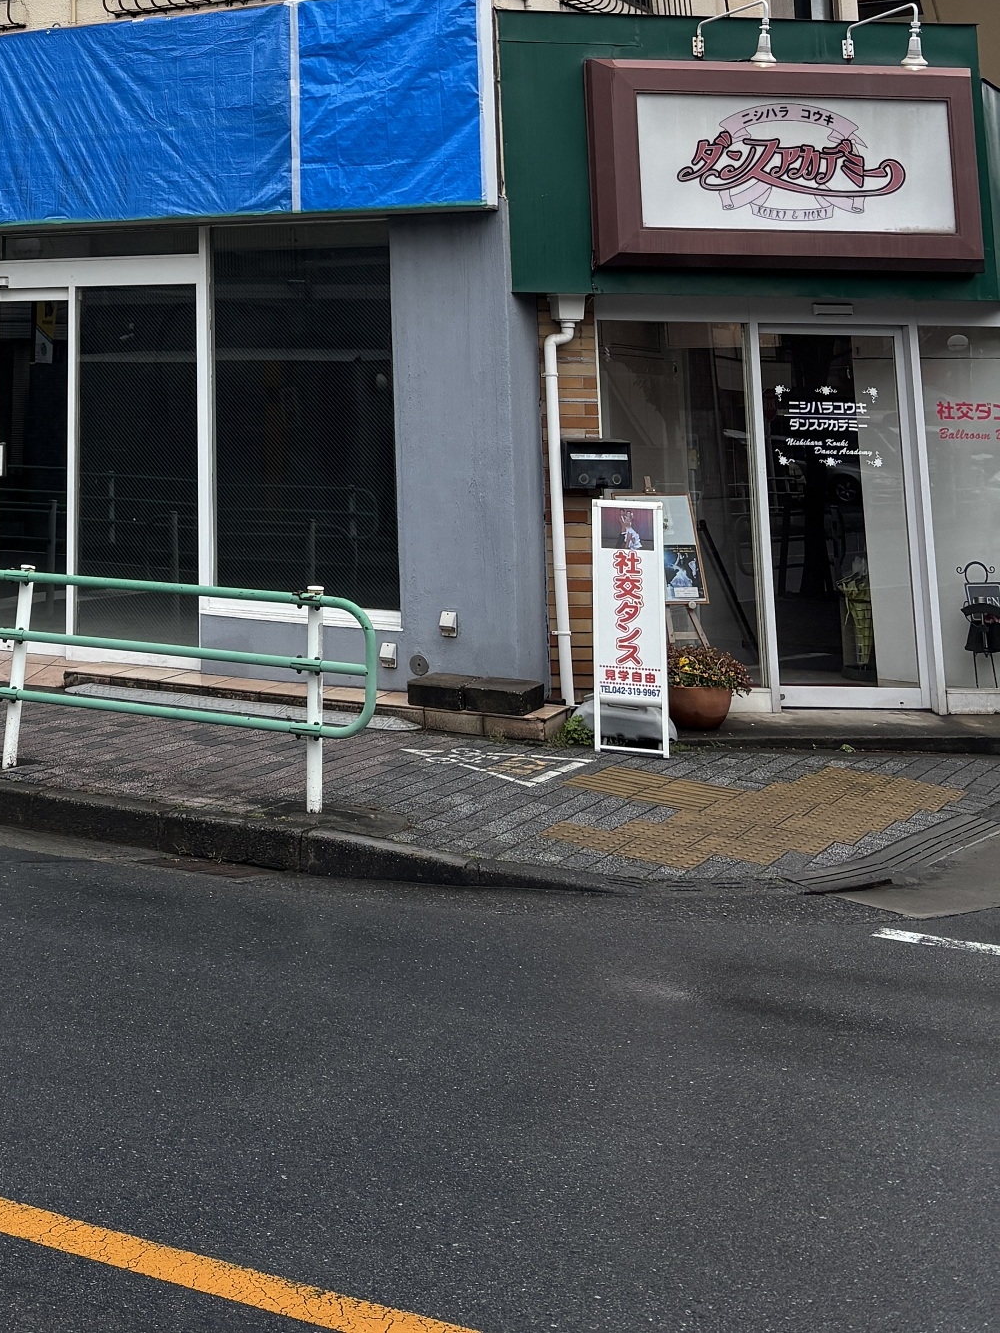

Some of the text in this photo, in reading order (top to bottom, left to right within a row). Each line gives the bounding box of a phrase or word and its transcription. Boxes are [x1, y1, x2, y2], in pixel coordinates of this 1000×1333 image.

[741, 106, 834, 126] ニシハラ コウキ
[677, 131, 906, 197] ダンスアカデミー
[792, 210, 799, 220] &
[788, 401, 867, 415] ニシハラコウキ
[789, 418, 868, 432] ダンスアカデミー
[939, 427, 991, 440] Ballroom
[785, 437, 849, 447] Nishihara Kouki
[814, 446, 873, 457] Dance Academy
[613, 550, 644, 667] 社交ダンス
[605, 669, 656, 684] 見学自由
